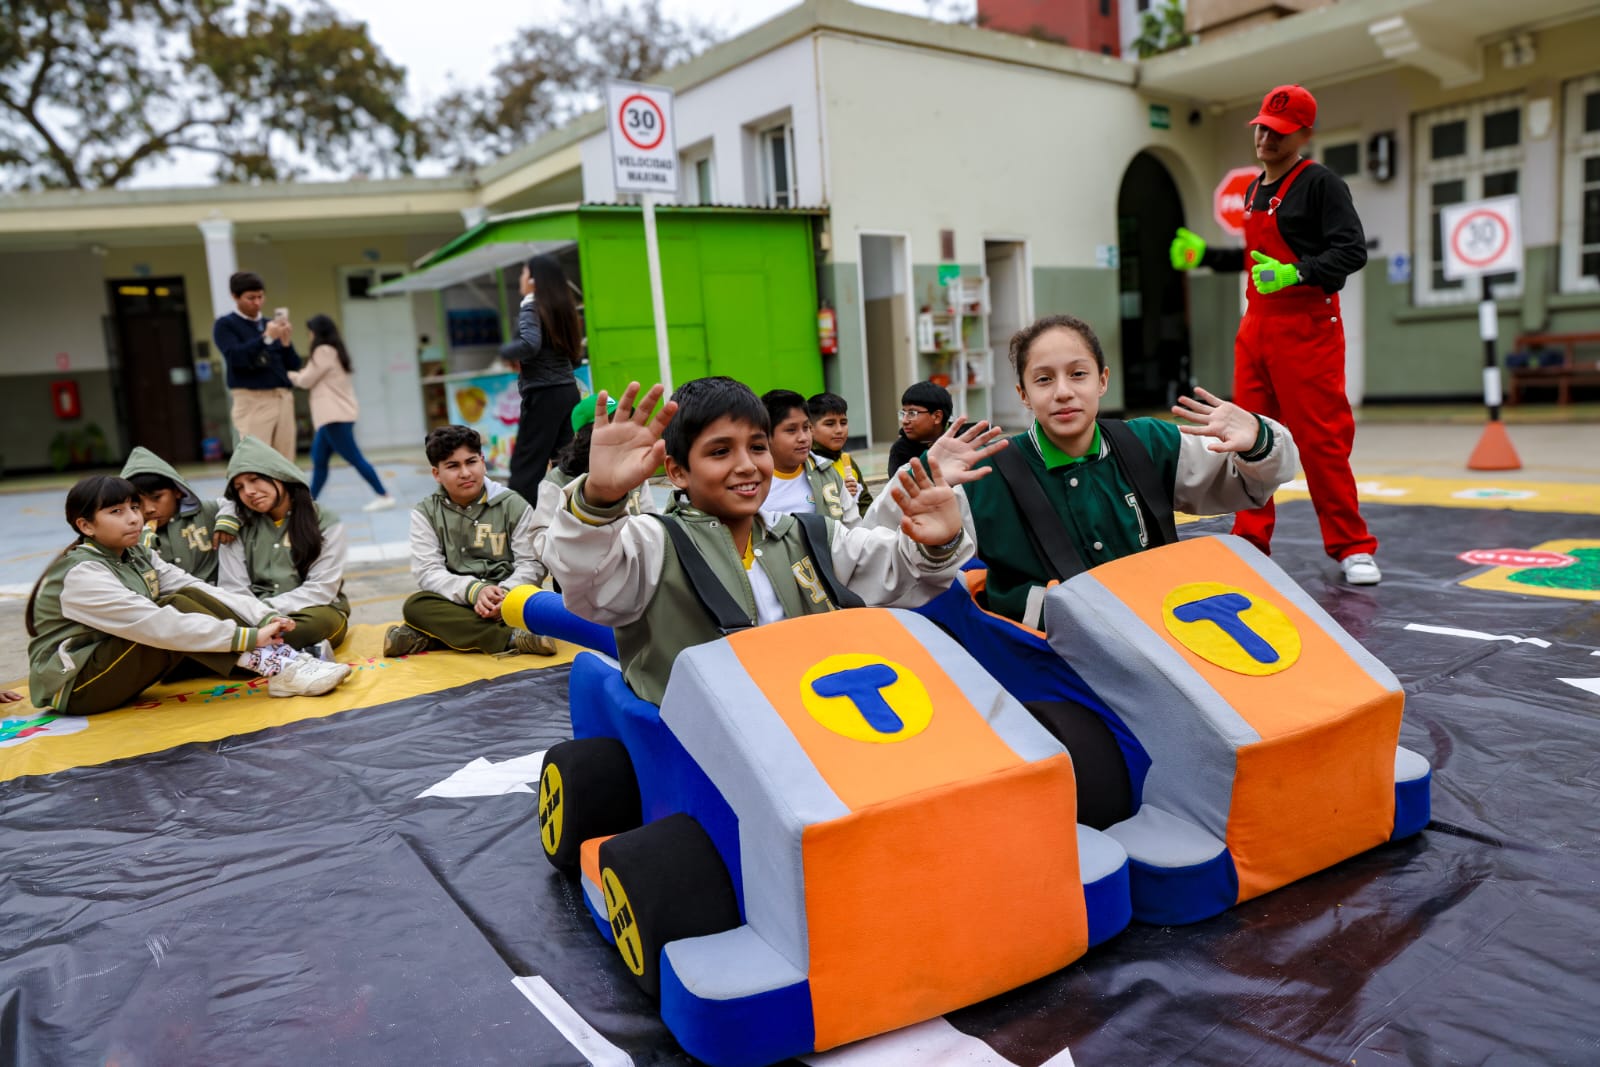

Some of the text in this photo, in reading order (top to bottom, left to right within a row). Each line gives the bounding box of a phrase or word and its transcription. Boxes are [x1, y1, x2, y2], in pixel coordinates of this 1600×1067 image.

[627, 108, 656, 130] 30
[618, 156, 673, 170] VELOCIDAD
[1466, 219, 1497, 249] 30
[473, 523, 506, 556] FV
[1173, 593, 1280, 664] T
[811, 664, 904, 733] T
